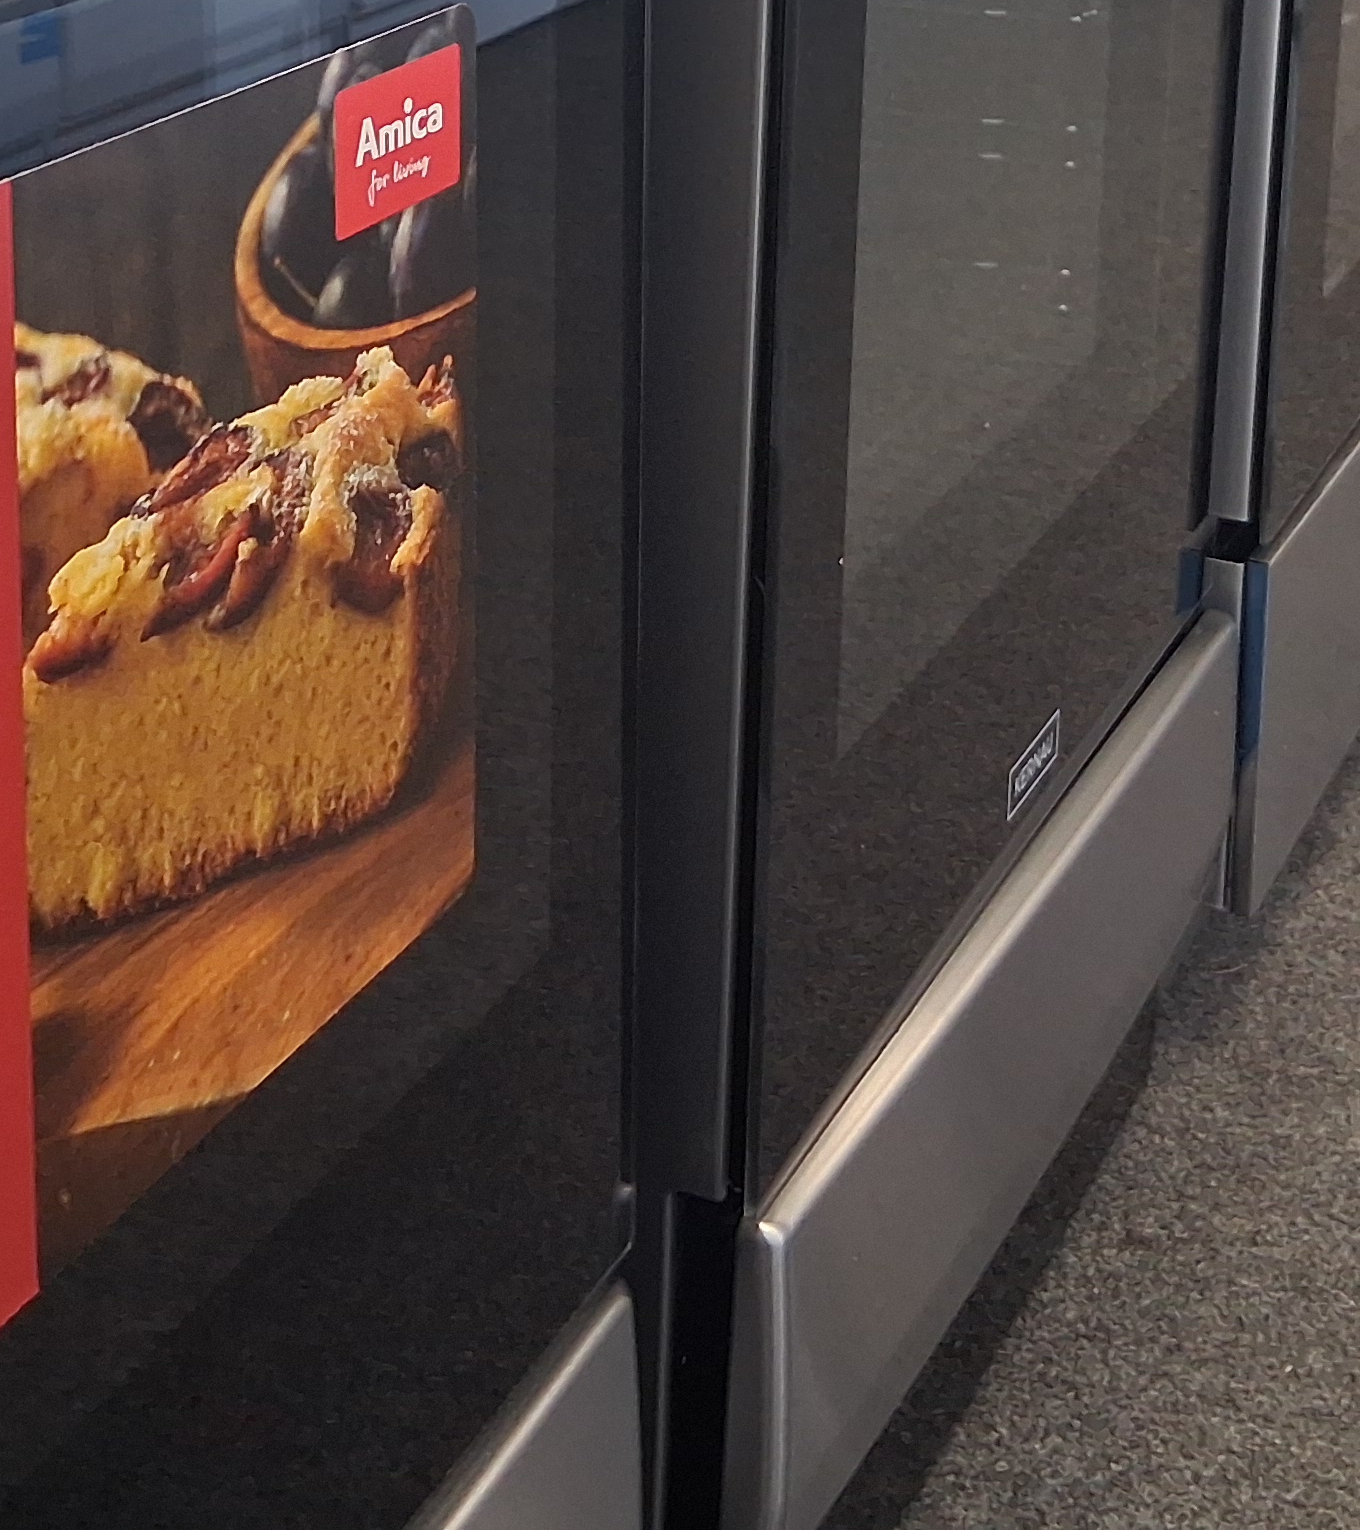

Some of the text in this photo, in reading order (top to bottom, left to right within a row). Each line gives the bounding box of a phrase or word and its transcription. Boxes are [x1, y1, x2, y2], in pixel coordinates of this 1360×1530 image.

[355, 97, 443, 168] Amica
[368, 155, 431, 208] for living
